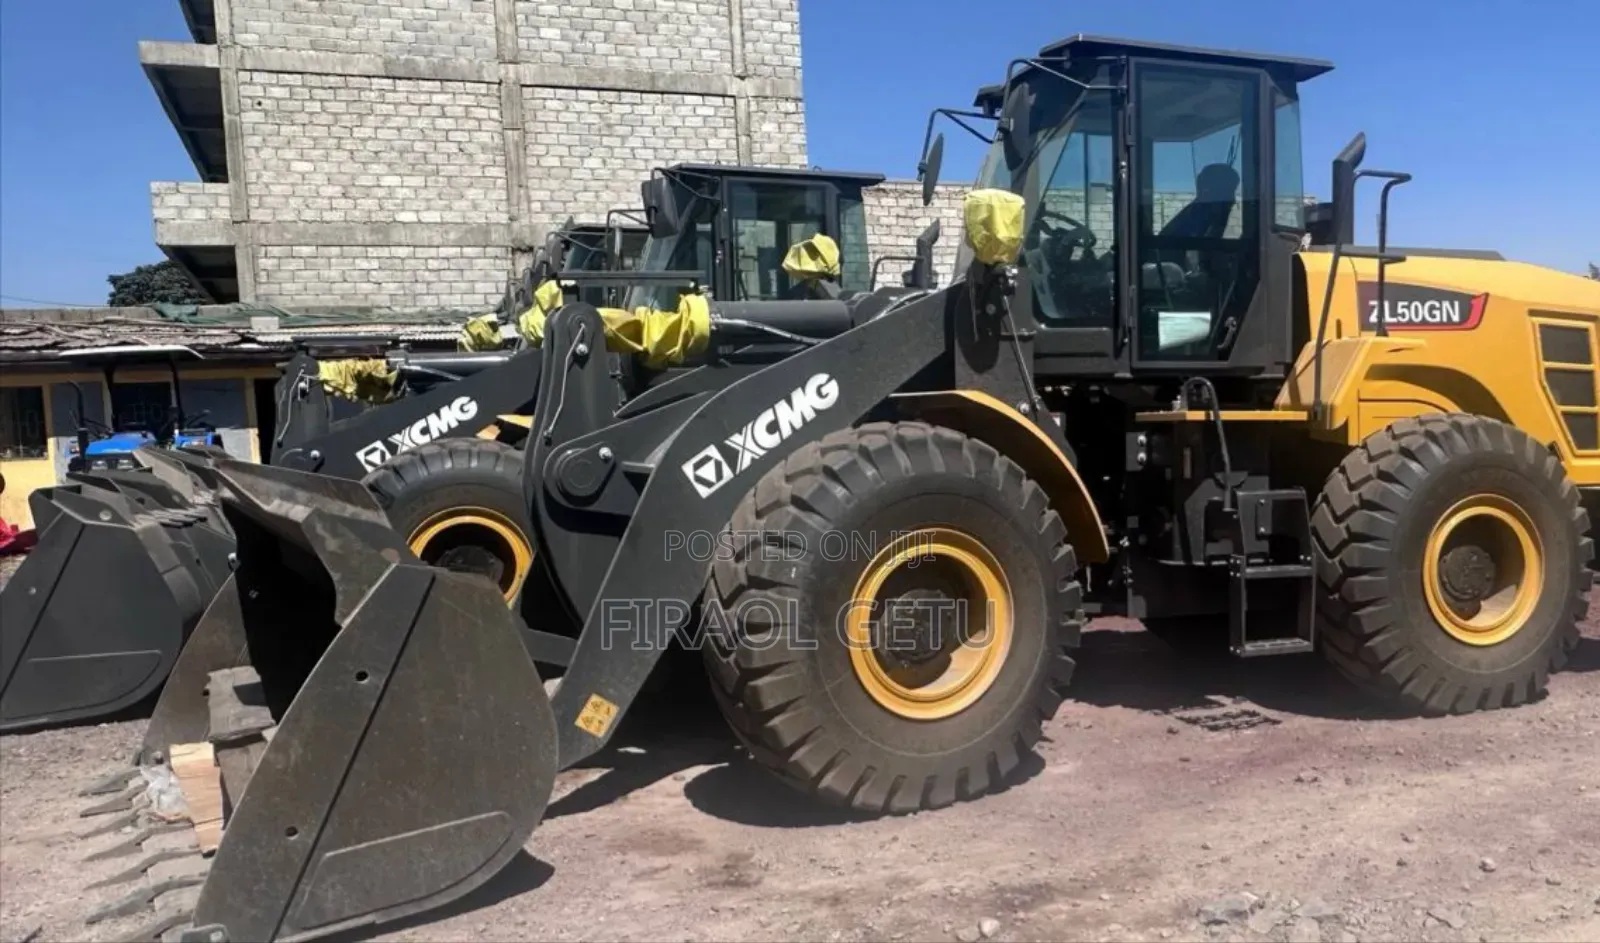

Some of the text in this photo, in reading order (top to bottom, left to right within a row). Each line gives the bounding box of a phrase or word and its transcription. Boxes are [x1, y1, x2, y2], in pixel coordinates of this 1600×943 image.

[1368, 299, 1461, 323] ZL50GN
[387, 396, 479, 456] XCMG
[724, 372, 840, 476] XCMG
